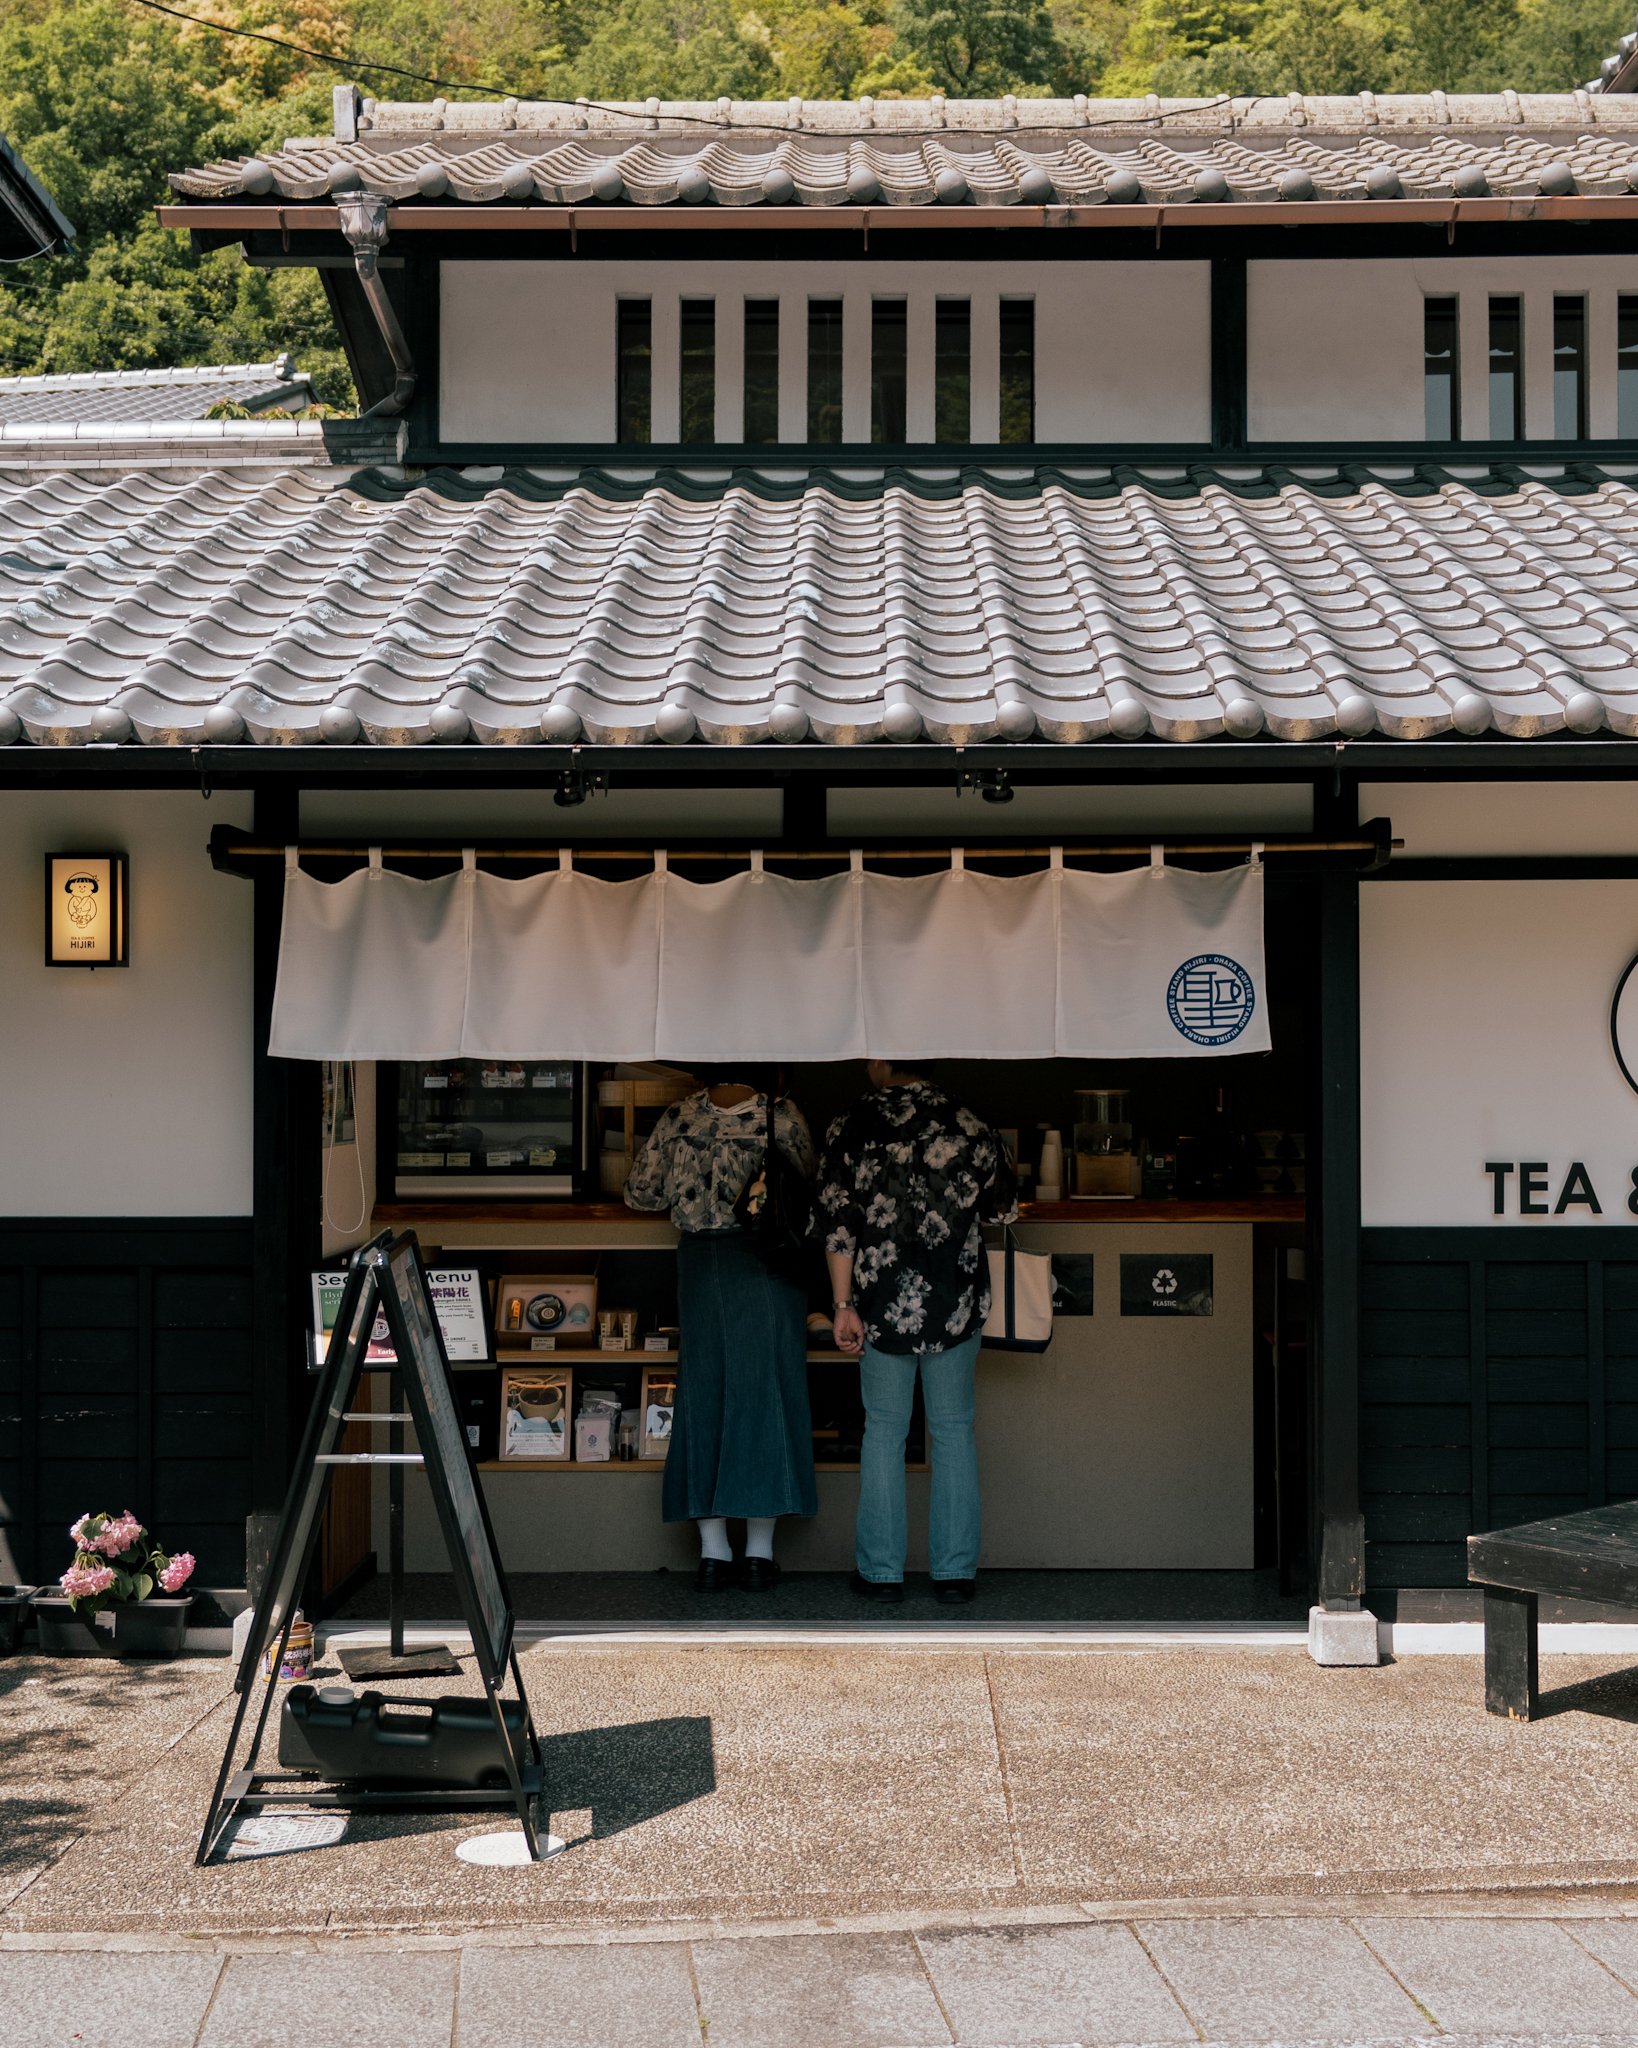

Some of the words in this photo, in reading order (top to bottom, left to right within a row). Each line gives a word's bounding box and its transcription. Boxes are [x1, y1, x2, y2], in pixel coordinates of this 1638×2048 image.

[1184, 956, 1207, 971] HIJIRI
[1214, 956, 1238, 972] OHARA
[1170, 970, 1184, 996] STAND
[1237, 970, 1253, 998] COFFEE
[1169, 998, 1184, 1028] COFFEE
[1238, 1002, 1252, 1028] STAND
[1184, 1028, 1210, 1043] OHARA
[1216, 1028, 1240, 1043] HIJIRI
[1485, 1162, 1603, 1215] TEA
